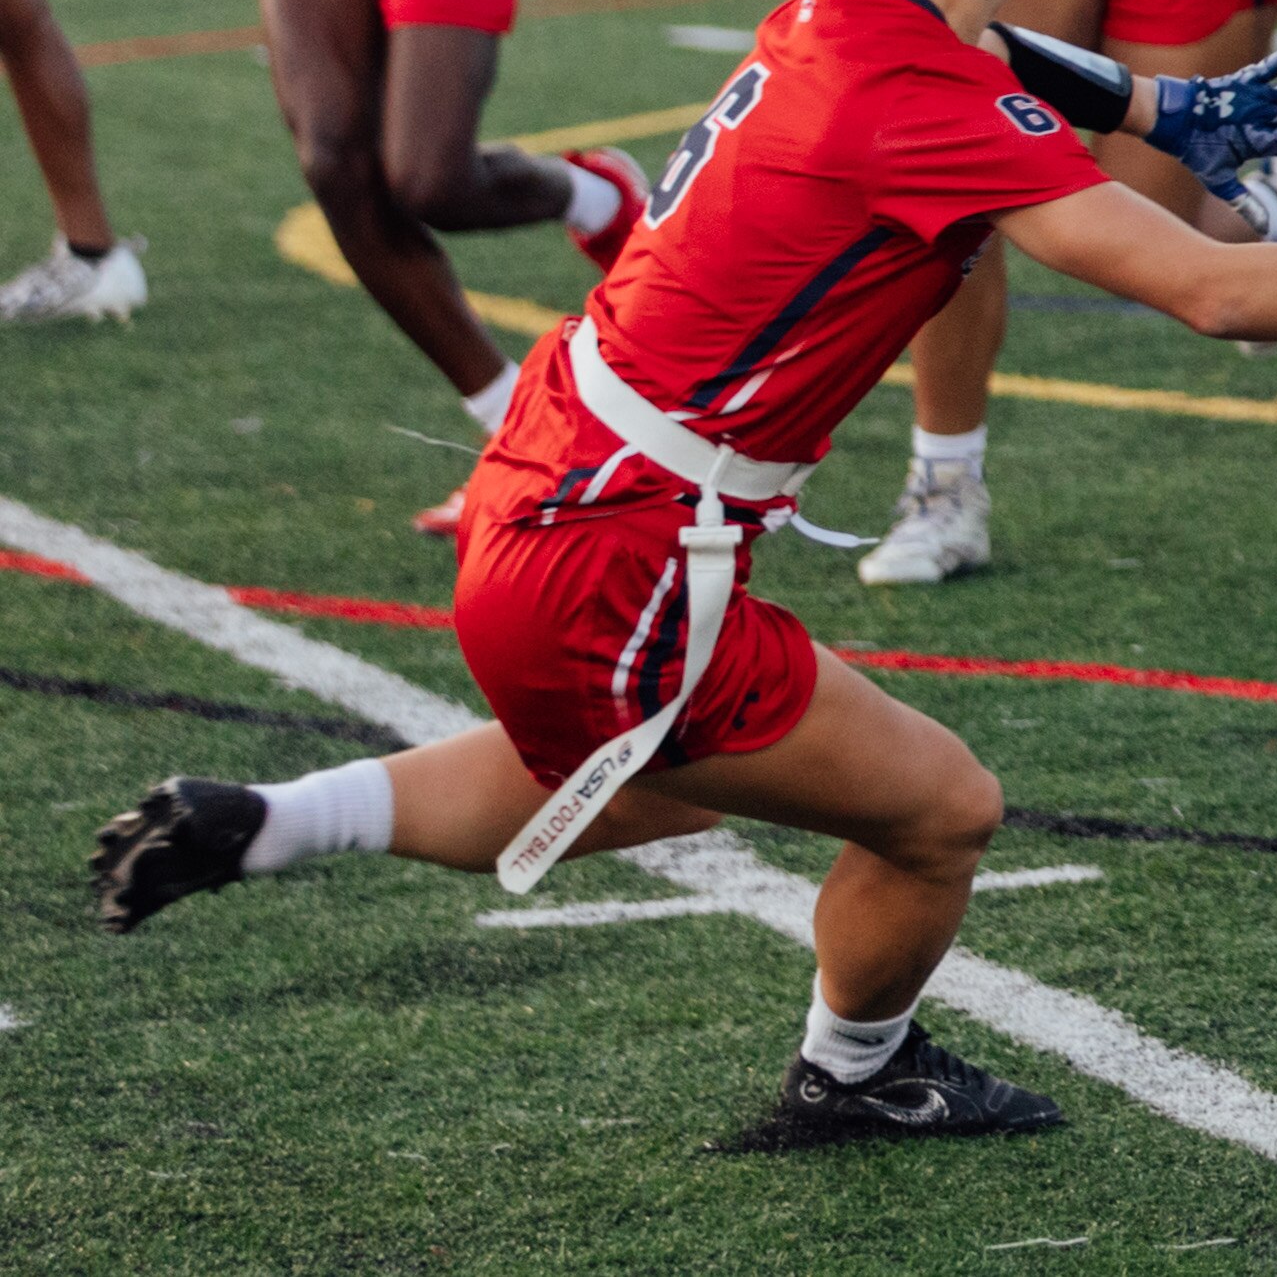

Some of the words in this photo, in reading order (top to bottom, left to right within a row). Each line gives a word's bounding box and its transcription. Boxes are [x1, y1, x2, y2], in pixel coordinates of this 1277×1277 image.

[995, 92, 1062, 136] 6
[643, 61, 772, 231] 6
[575, 756, 617, 800] USA
[508, 794, 585, 874] FOOTBALL
